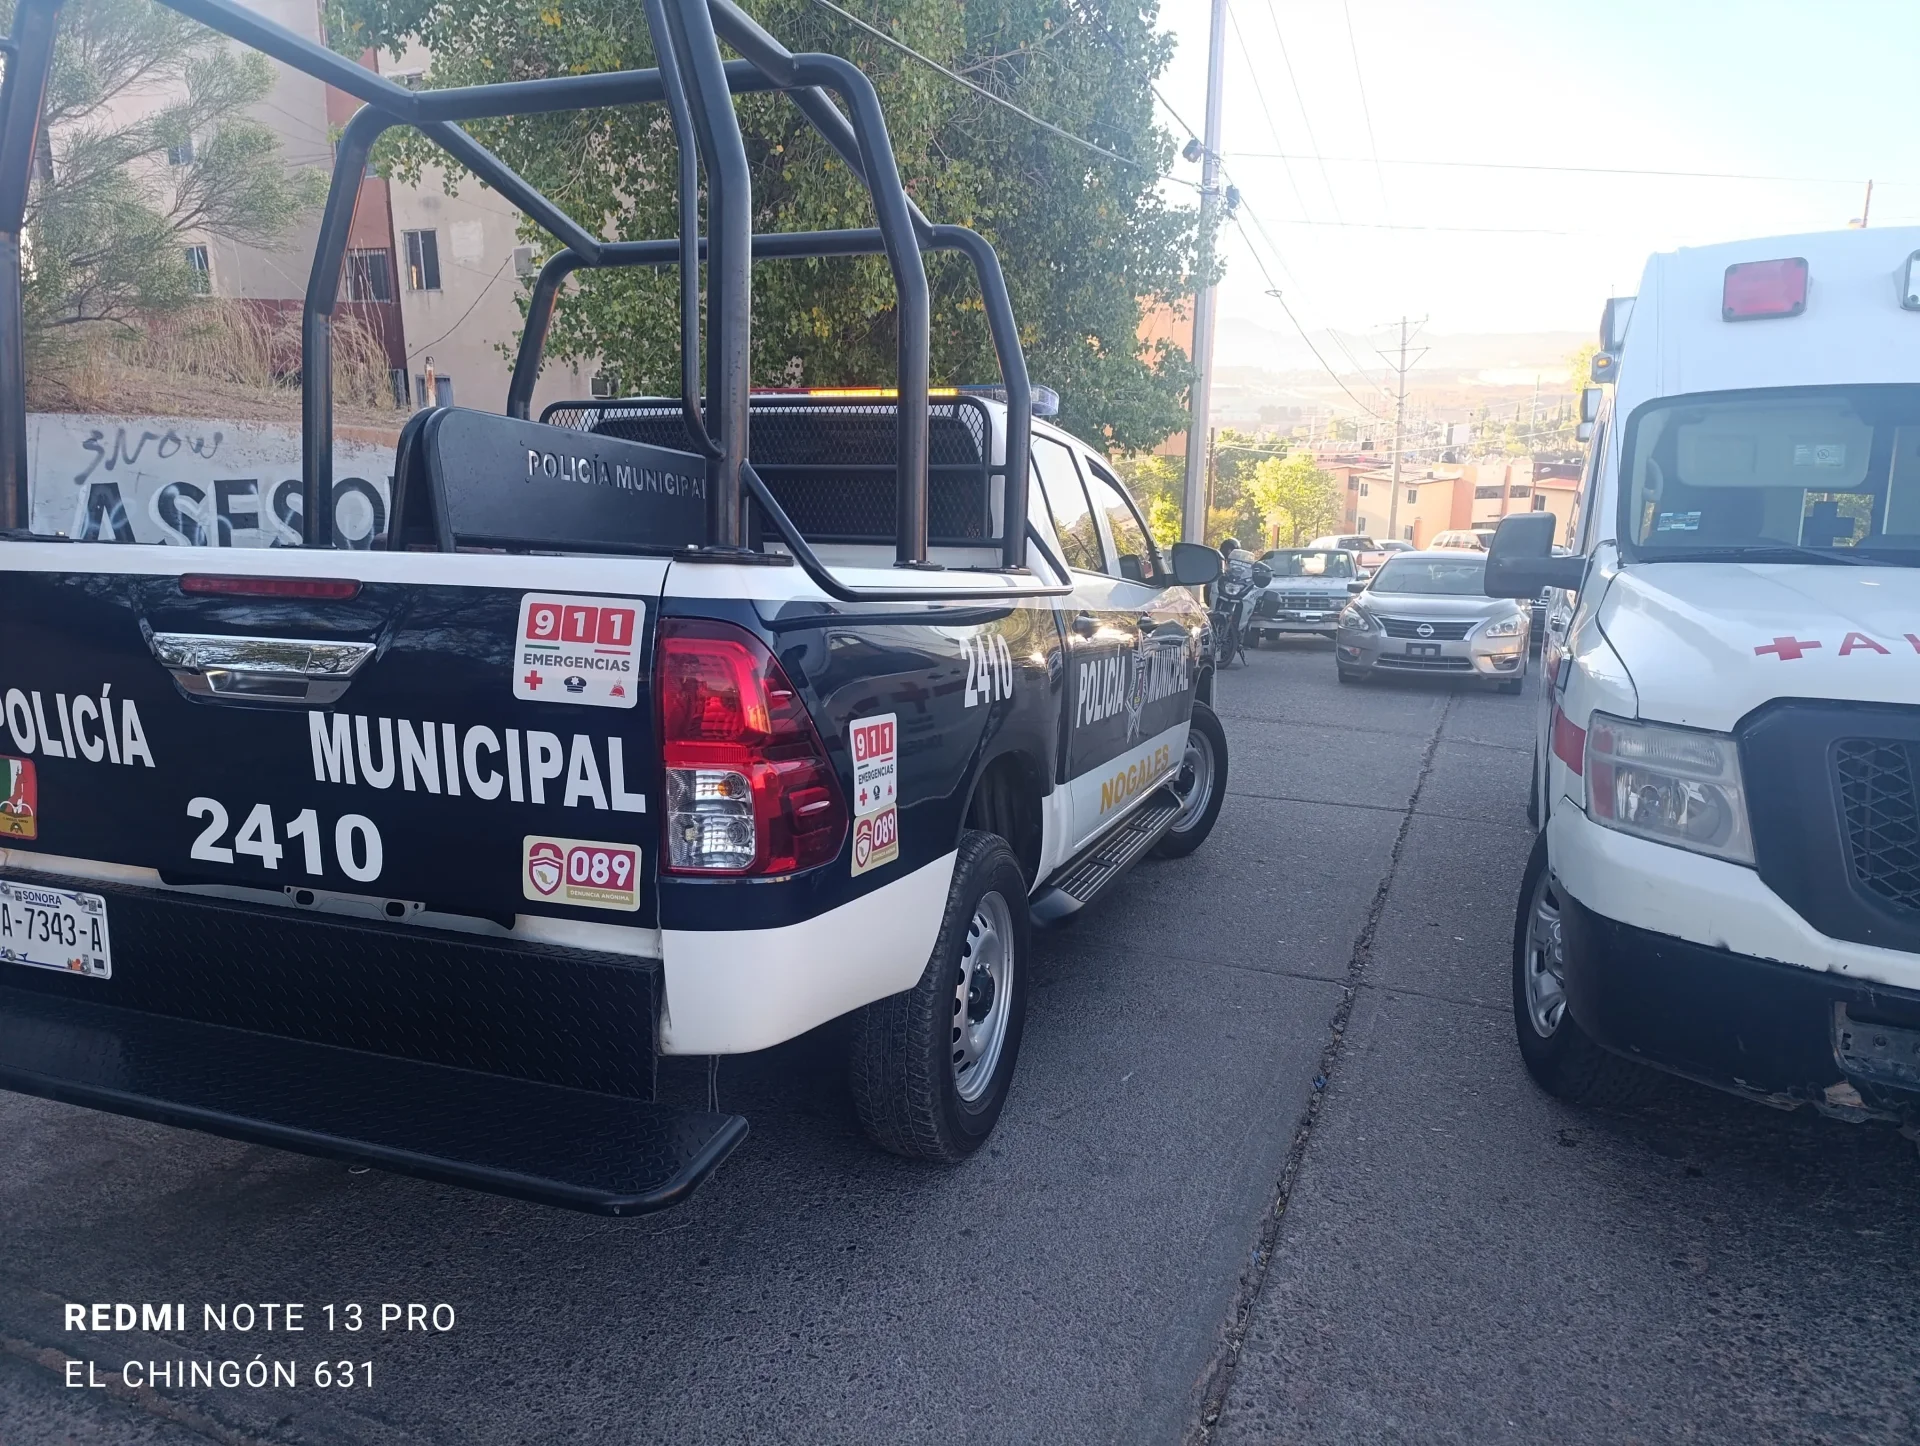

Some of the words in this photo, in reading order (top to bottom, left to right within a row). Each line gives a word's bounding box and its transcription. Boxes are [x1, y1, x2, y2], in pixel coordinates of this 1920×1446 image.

[528, 450, 612, 487] POLICÍA
[78, 476, 394, 551] ASESO
[535, 609, 623, 640] 911
[523, 653, 631, 672] EMERGENCIAS
[960, 634, 1013, 708] 2410
[1076, 644, 1126, 729] POLICÍA
[1147, 646, 1189, 704] MUNICIPAL
[856, 726, 890, 757] 911
[308, 710, 646, 814] MUNICIPAL
[858, 764, 894, 785] EMERGENCIAS
[1100, 744, 1169, 815] NOGALES
[187, 797, 383, 883] 2410
[874, 813, 894, 844] 089
[570, 850, 631, 887] 089
[22, 890, 62, 906] SONORA
[570, 889, 601, 899] DENUNCIA
